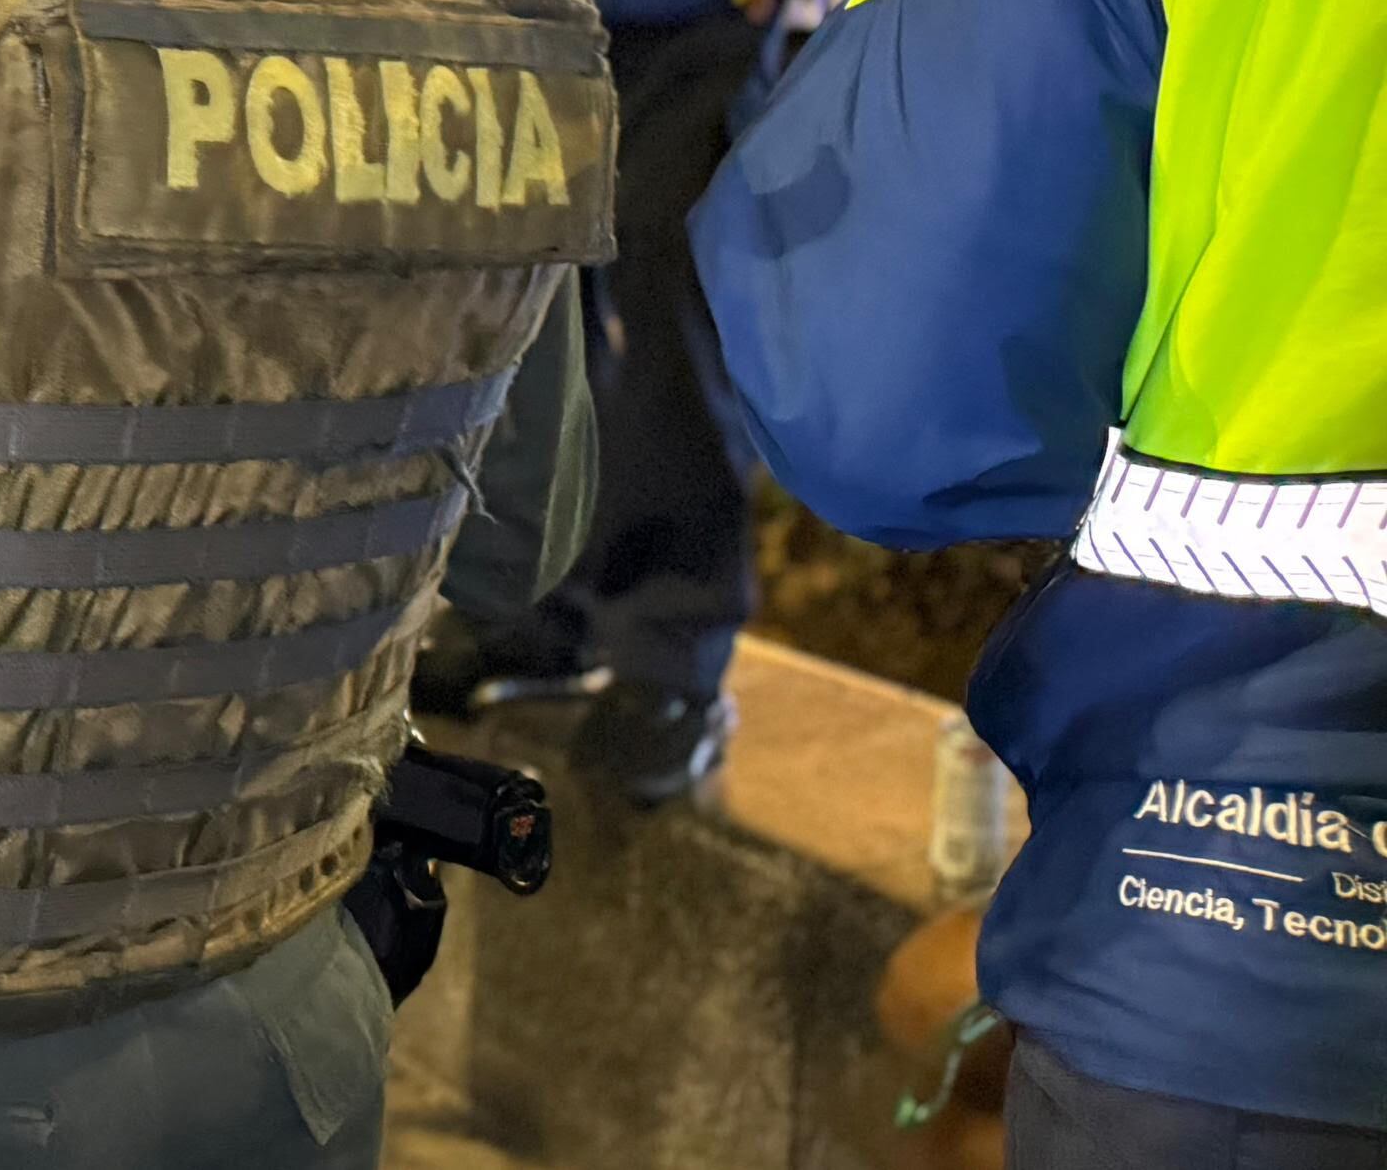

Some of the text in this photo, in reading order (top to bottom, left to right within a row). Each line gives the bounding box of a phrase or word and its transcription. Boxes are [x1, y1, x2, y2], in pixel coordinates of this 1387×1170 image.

[158, 48, 570, 209] POLICIA
[1119, 875, 1387, 949] Ciencia, Tecno
